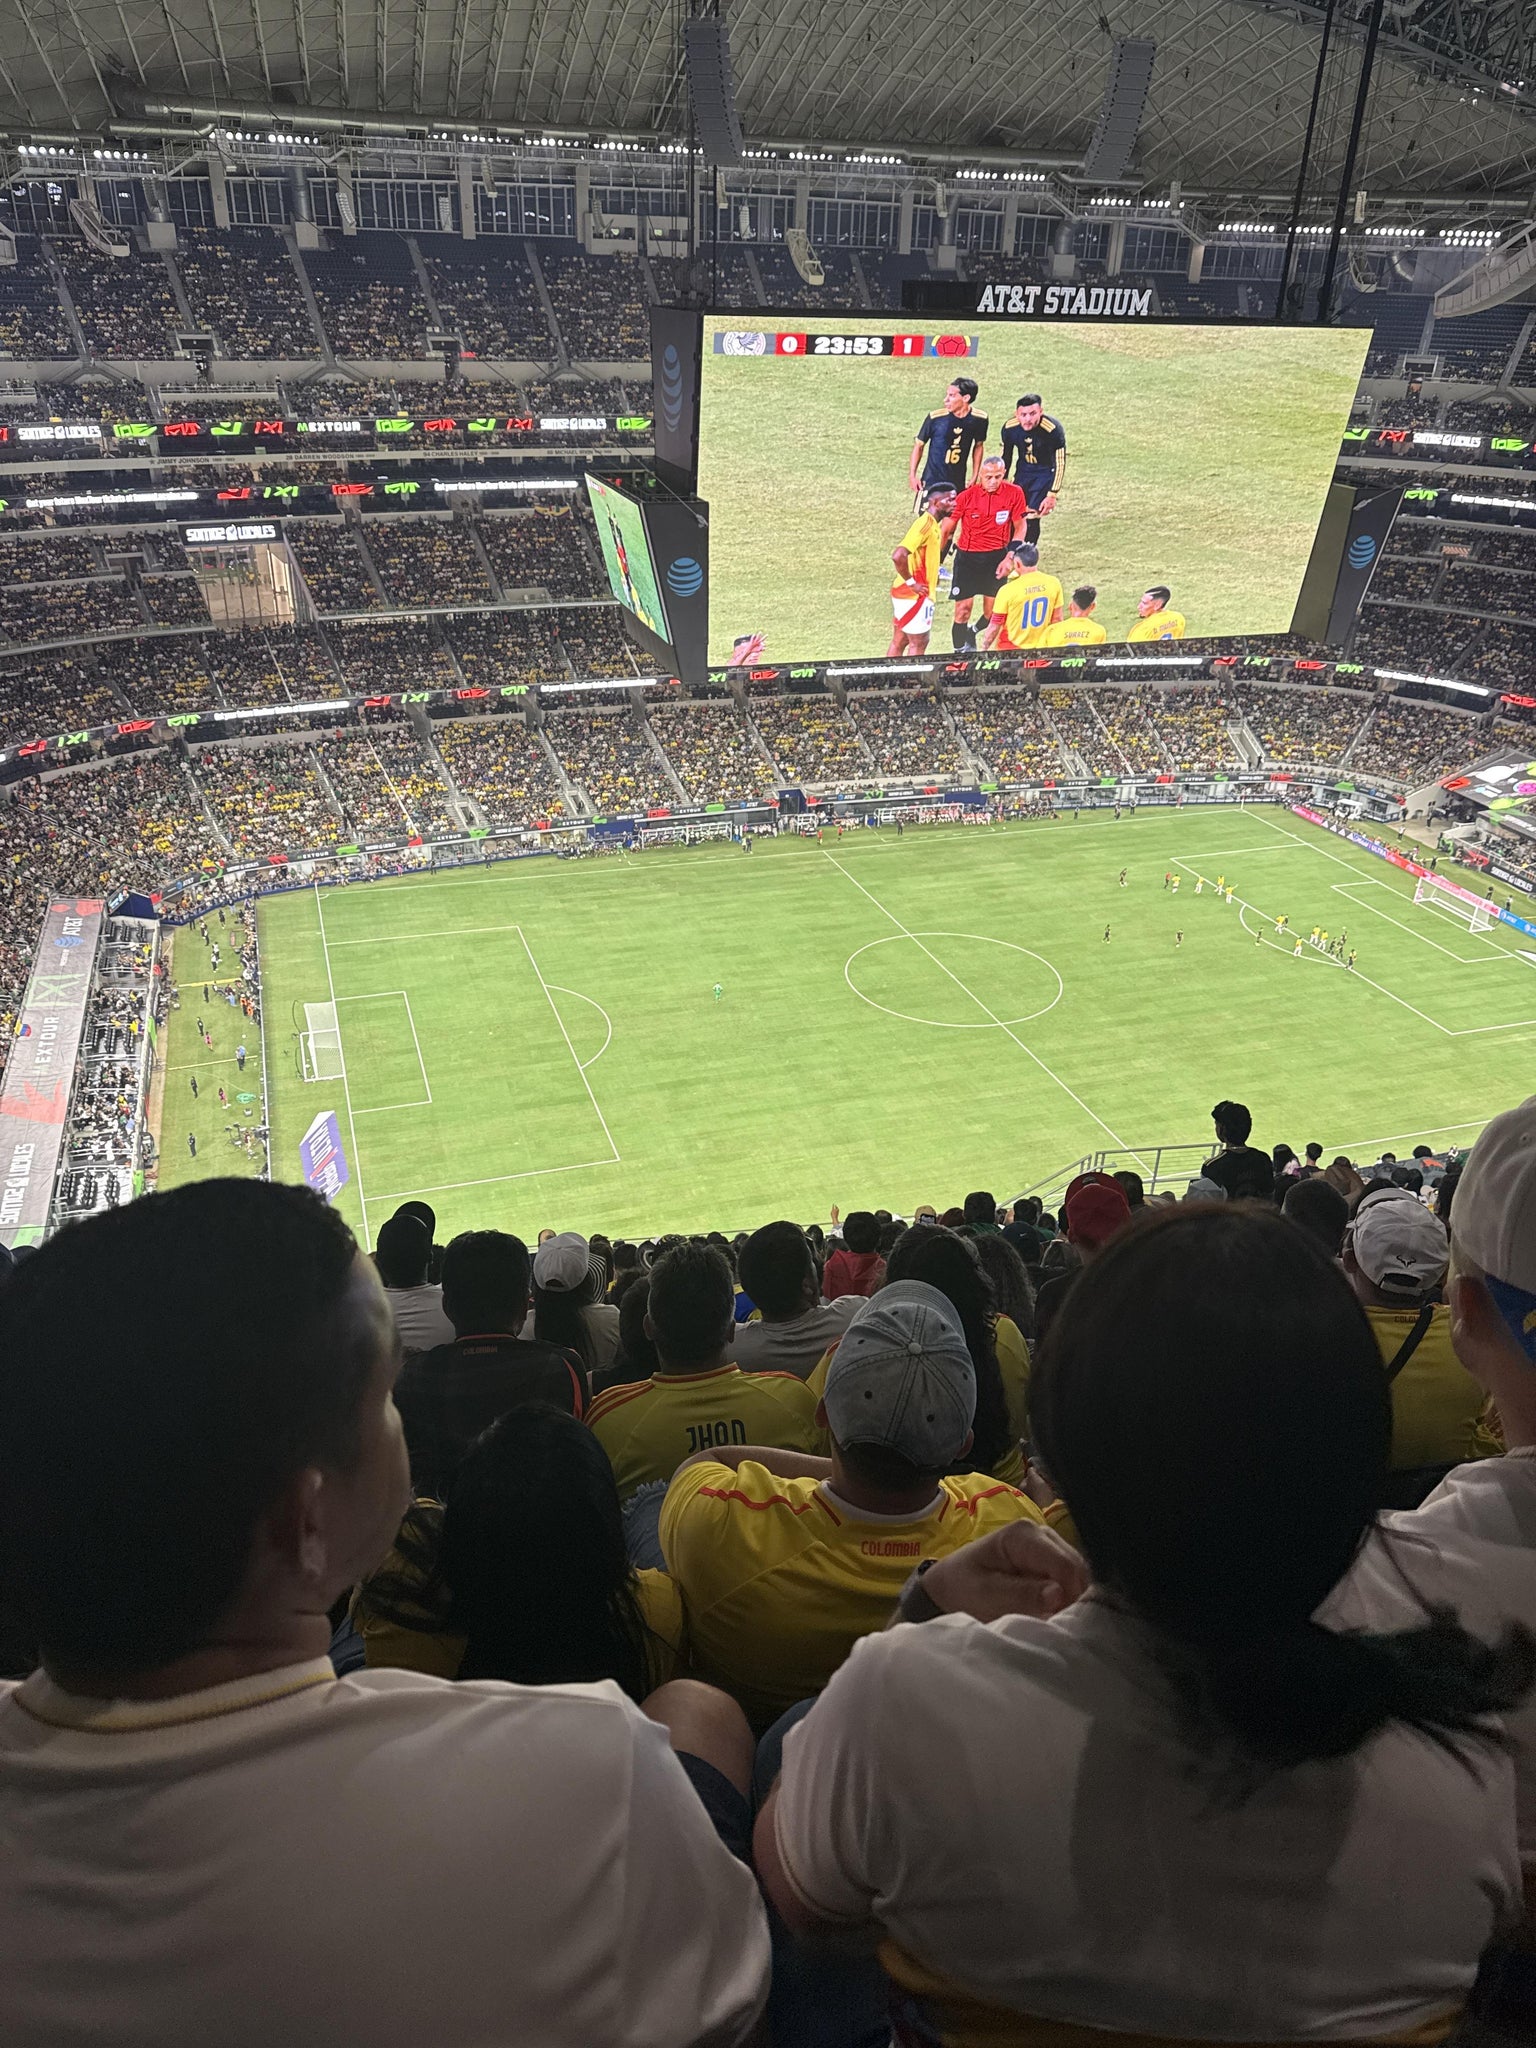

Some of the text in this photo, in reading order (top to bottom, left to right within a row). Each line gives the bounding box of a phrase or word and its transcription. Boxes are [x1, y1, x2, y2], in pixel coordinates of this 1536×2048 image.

[976, 285, 1153, 316] AT&T STADIUM
[782, 336, 798, 353] 0
[814, 336, 883, 355] 23:53
[903, 337, 912, 354] 1
[297, 421, 361, 432] MEXTOUR
[945, 449, 962, 464] 16
[1025, 585, 1046, 595] JAMES
[1022, 597, 1048, 629] 10
[62, 916, 84, 936] AT&T
[308, 1122, 334, 1169] ULTRA
[861, 1541, 920, 1557] COLOMBIA
